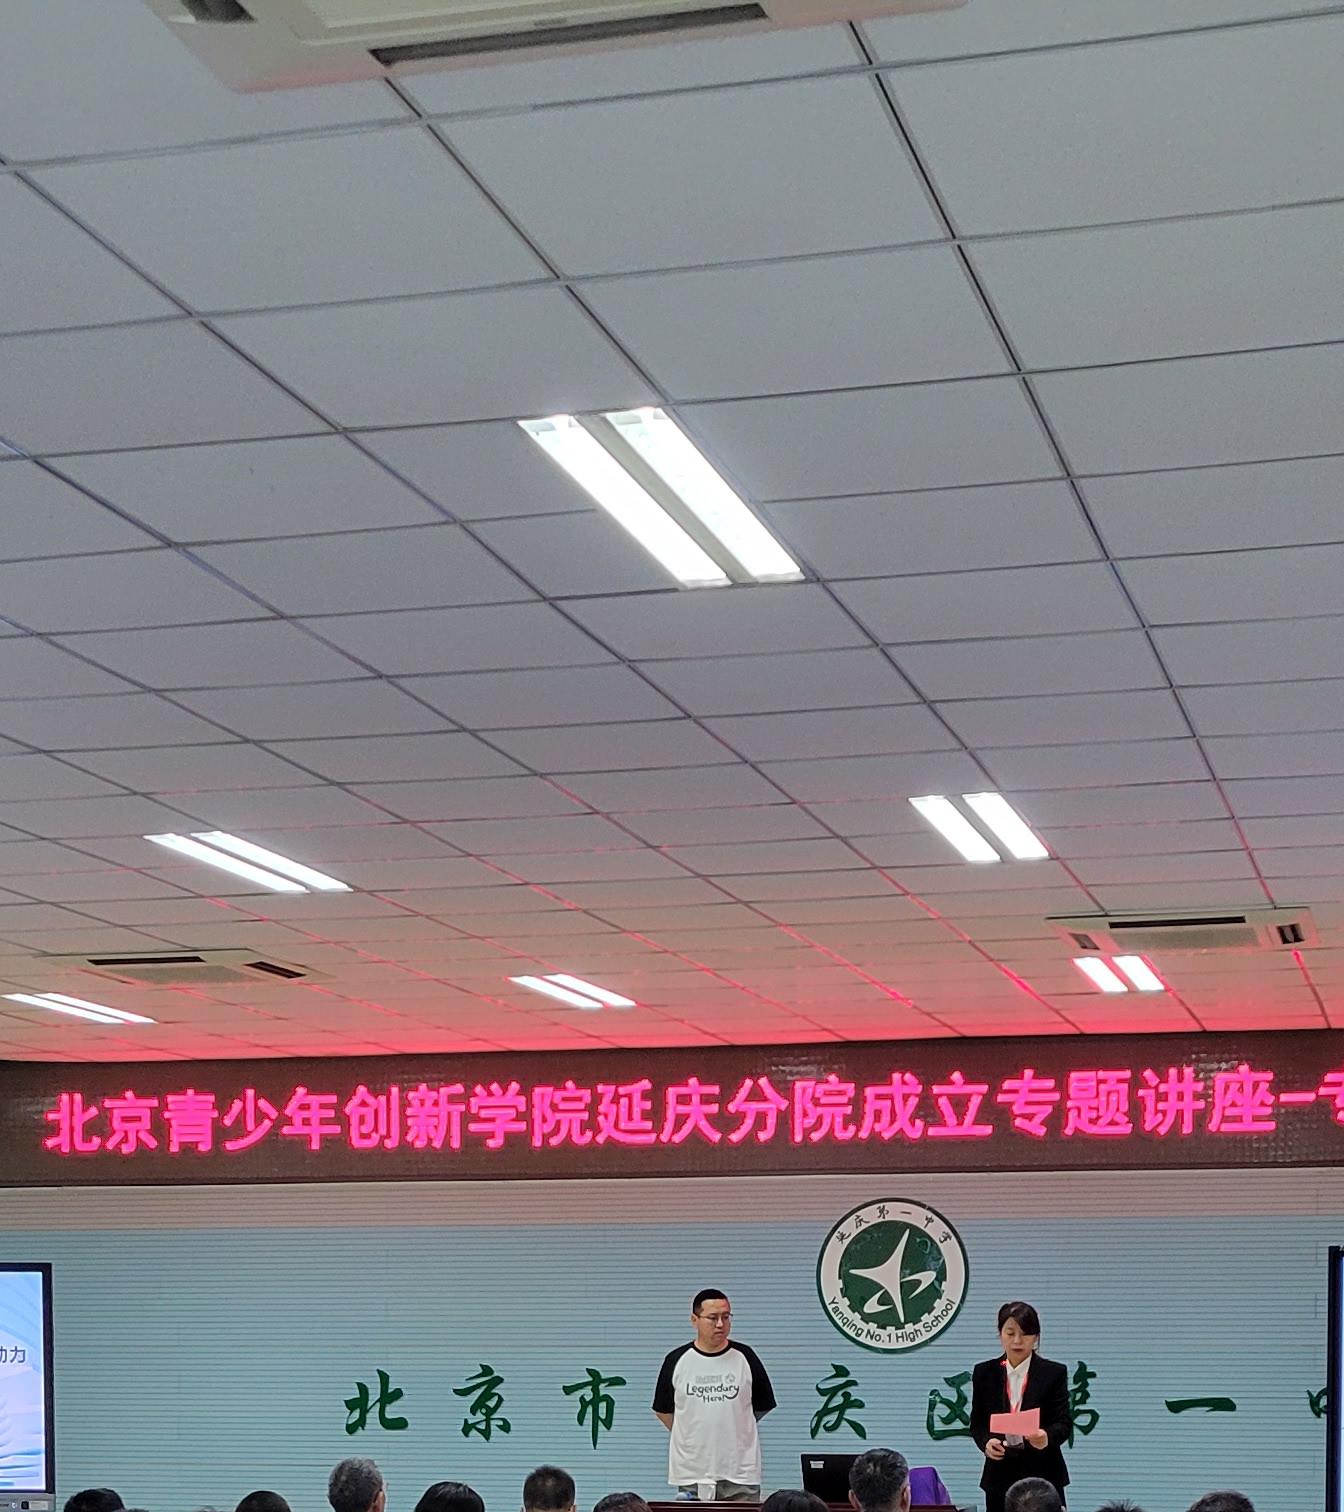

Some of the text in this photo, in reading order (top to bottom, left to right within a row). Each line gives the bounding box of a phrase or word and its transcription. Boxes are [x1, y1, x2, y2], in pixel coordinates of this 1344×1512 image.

[827, 1297, 864, 1337] Yanqing
[896, 1327, 922, 1343] High
[923, 1299, 956, 1332] School
[686, 1383, 740, 1399] Legendary
